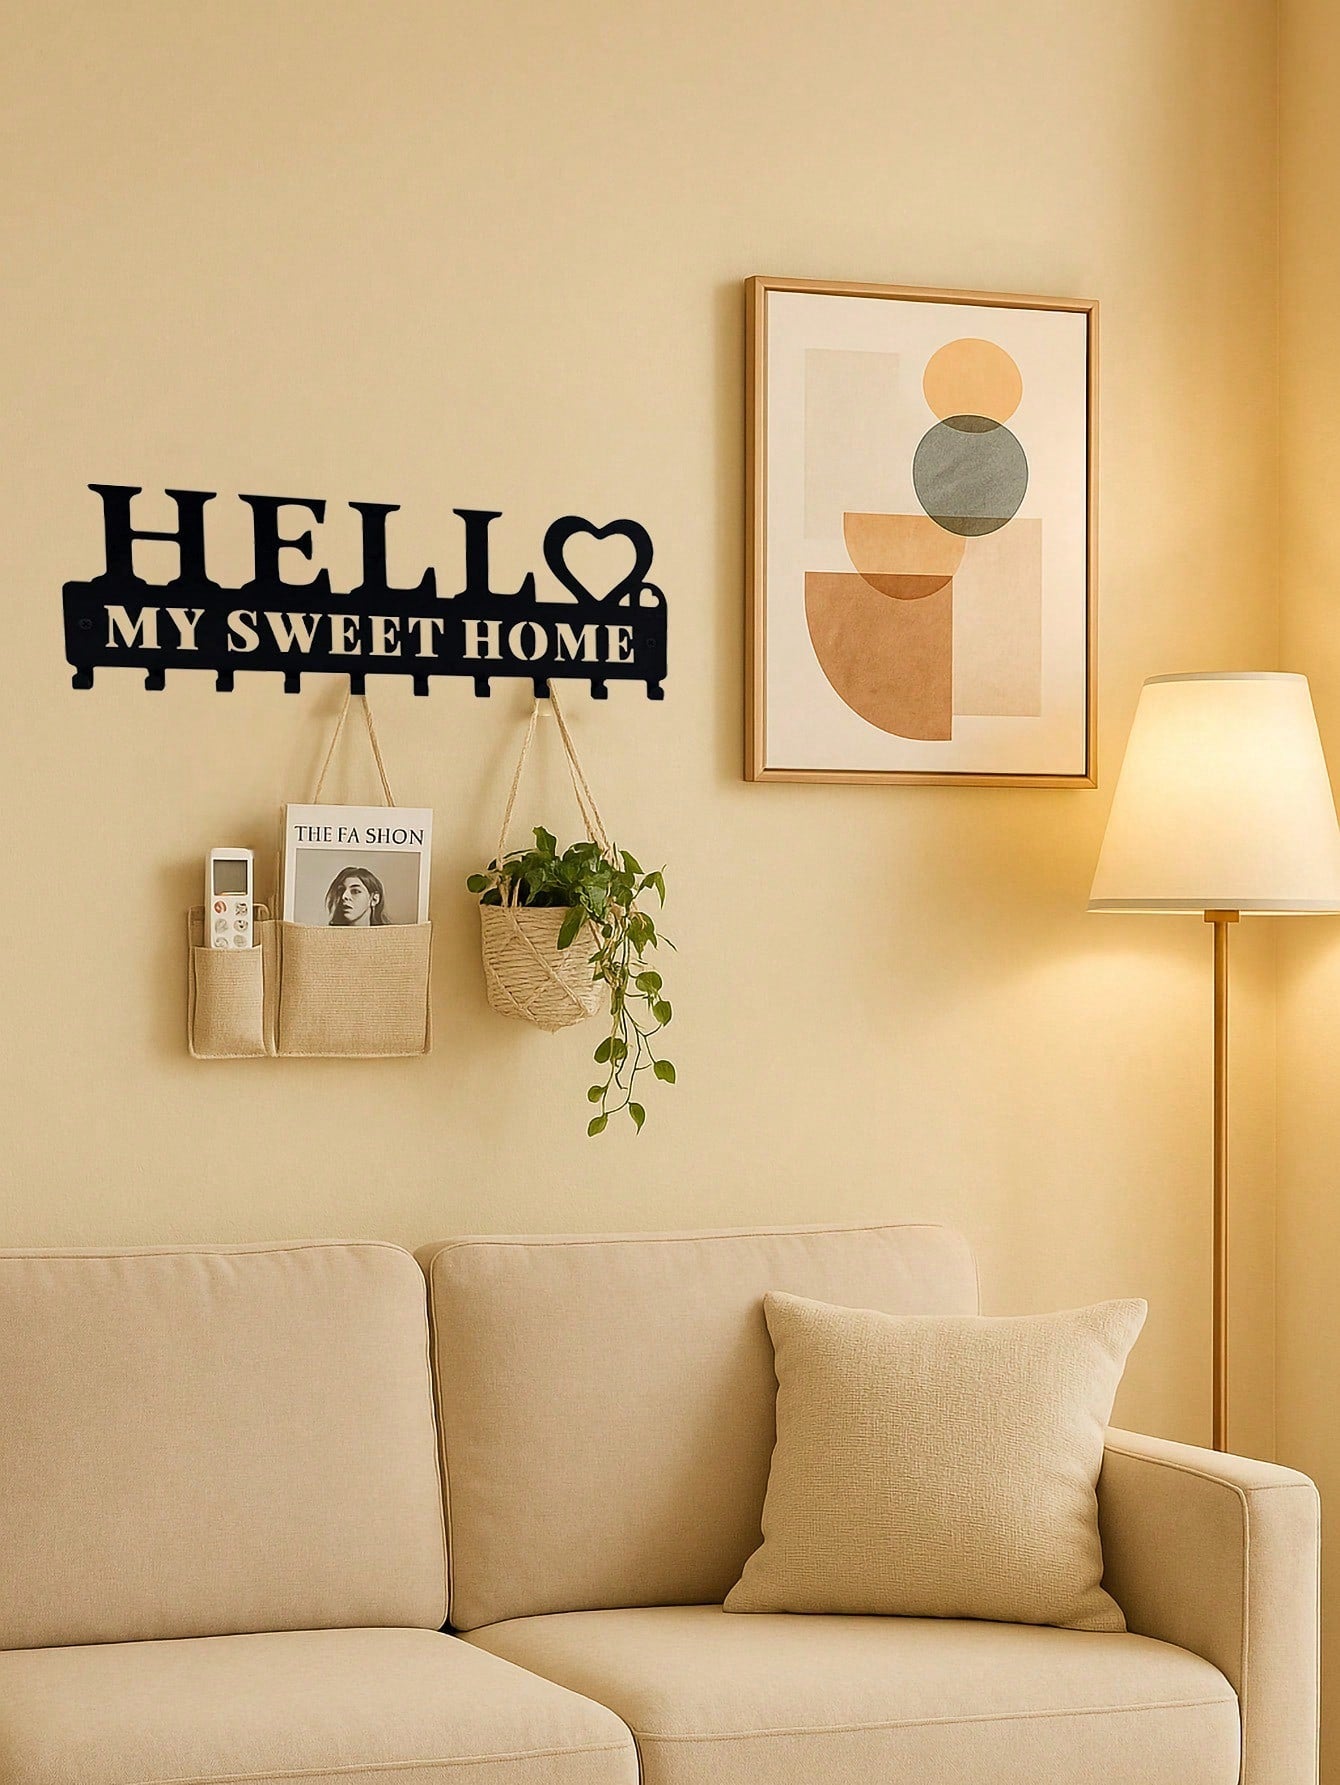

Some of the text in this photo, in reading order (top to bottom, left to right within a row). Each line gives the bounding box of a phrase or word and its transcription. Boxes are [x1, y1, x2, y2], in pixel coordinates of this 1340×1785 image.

[104, 605, 635, 663] MY SWEET HOME
[294, 825, 332, 843] THE
